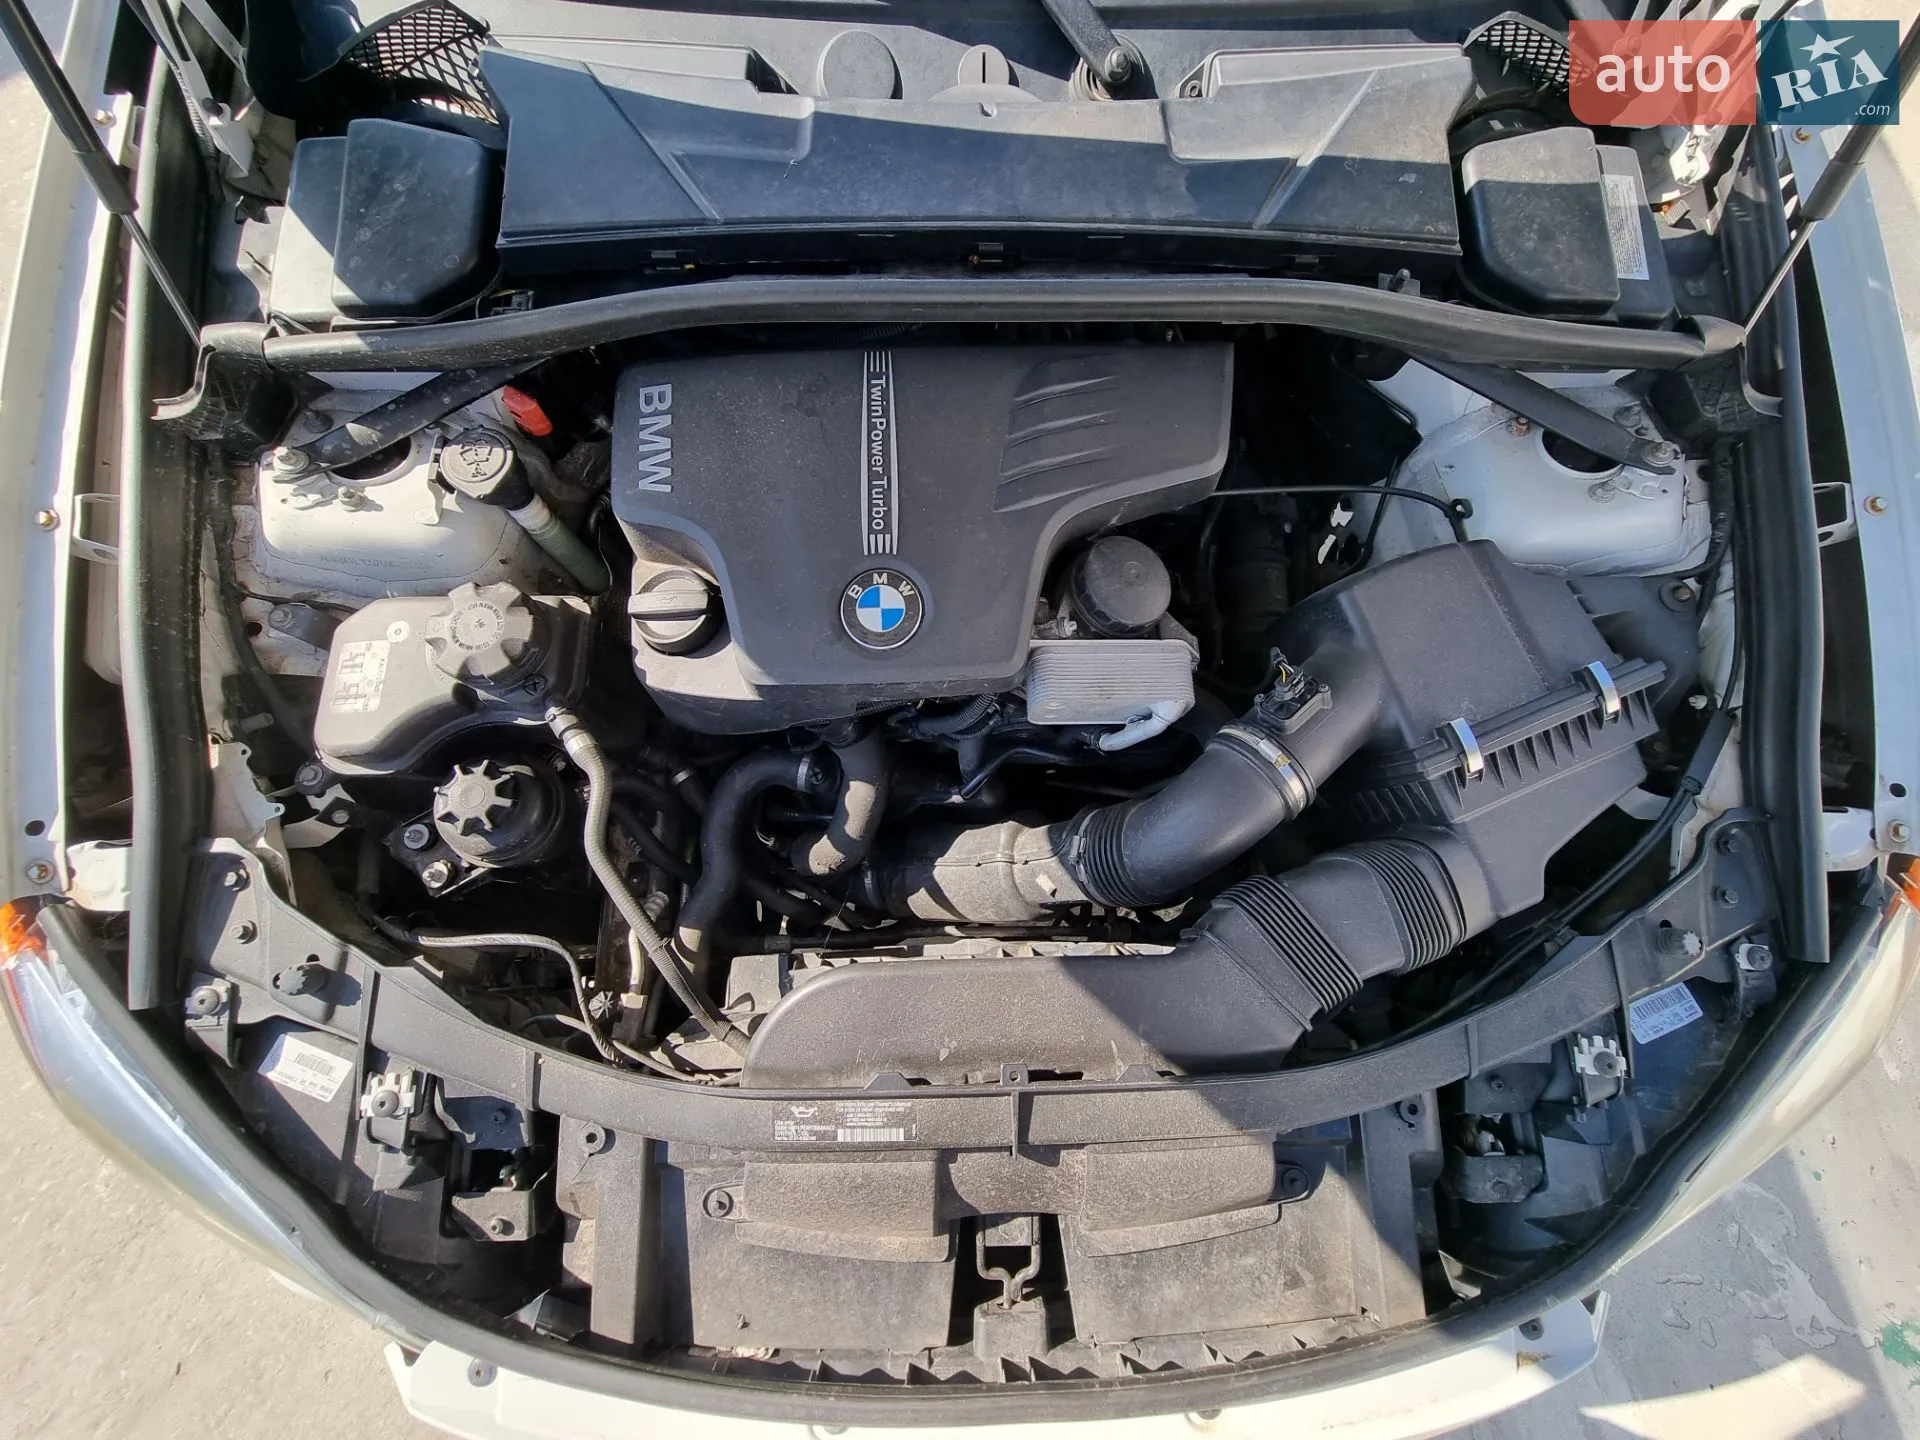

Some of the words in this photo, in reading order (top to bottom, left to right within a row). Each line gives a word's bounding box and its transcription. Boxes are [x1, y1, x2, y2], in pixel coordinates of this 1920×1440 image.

[638, 383, 673, 493] BMW
[870, 374, 887, 474] TwinPower
[871, 475, 888, 530] Turbo
[847, 572, 915, 600] BMW
